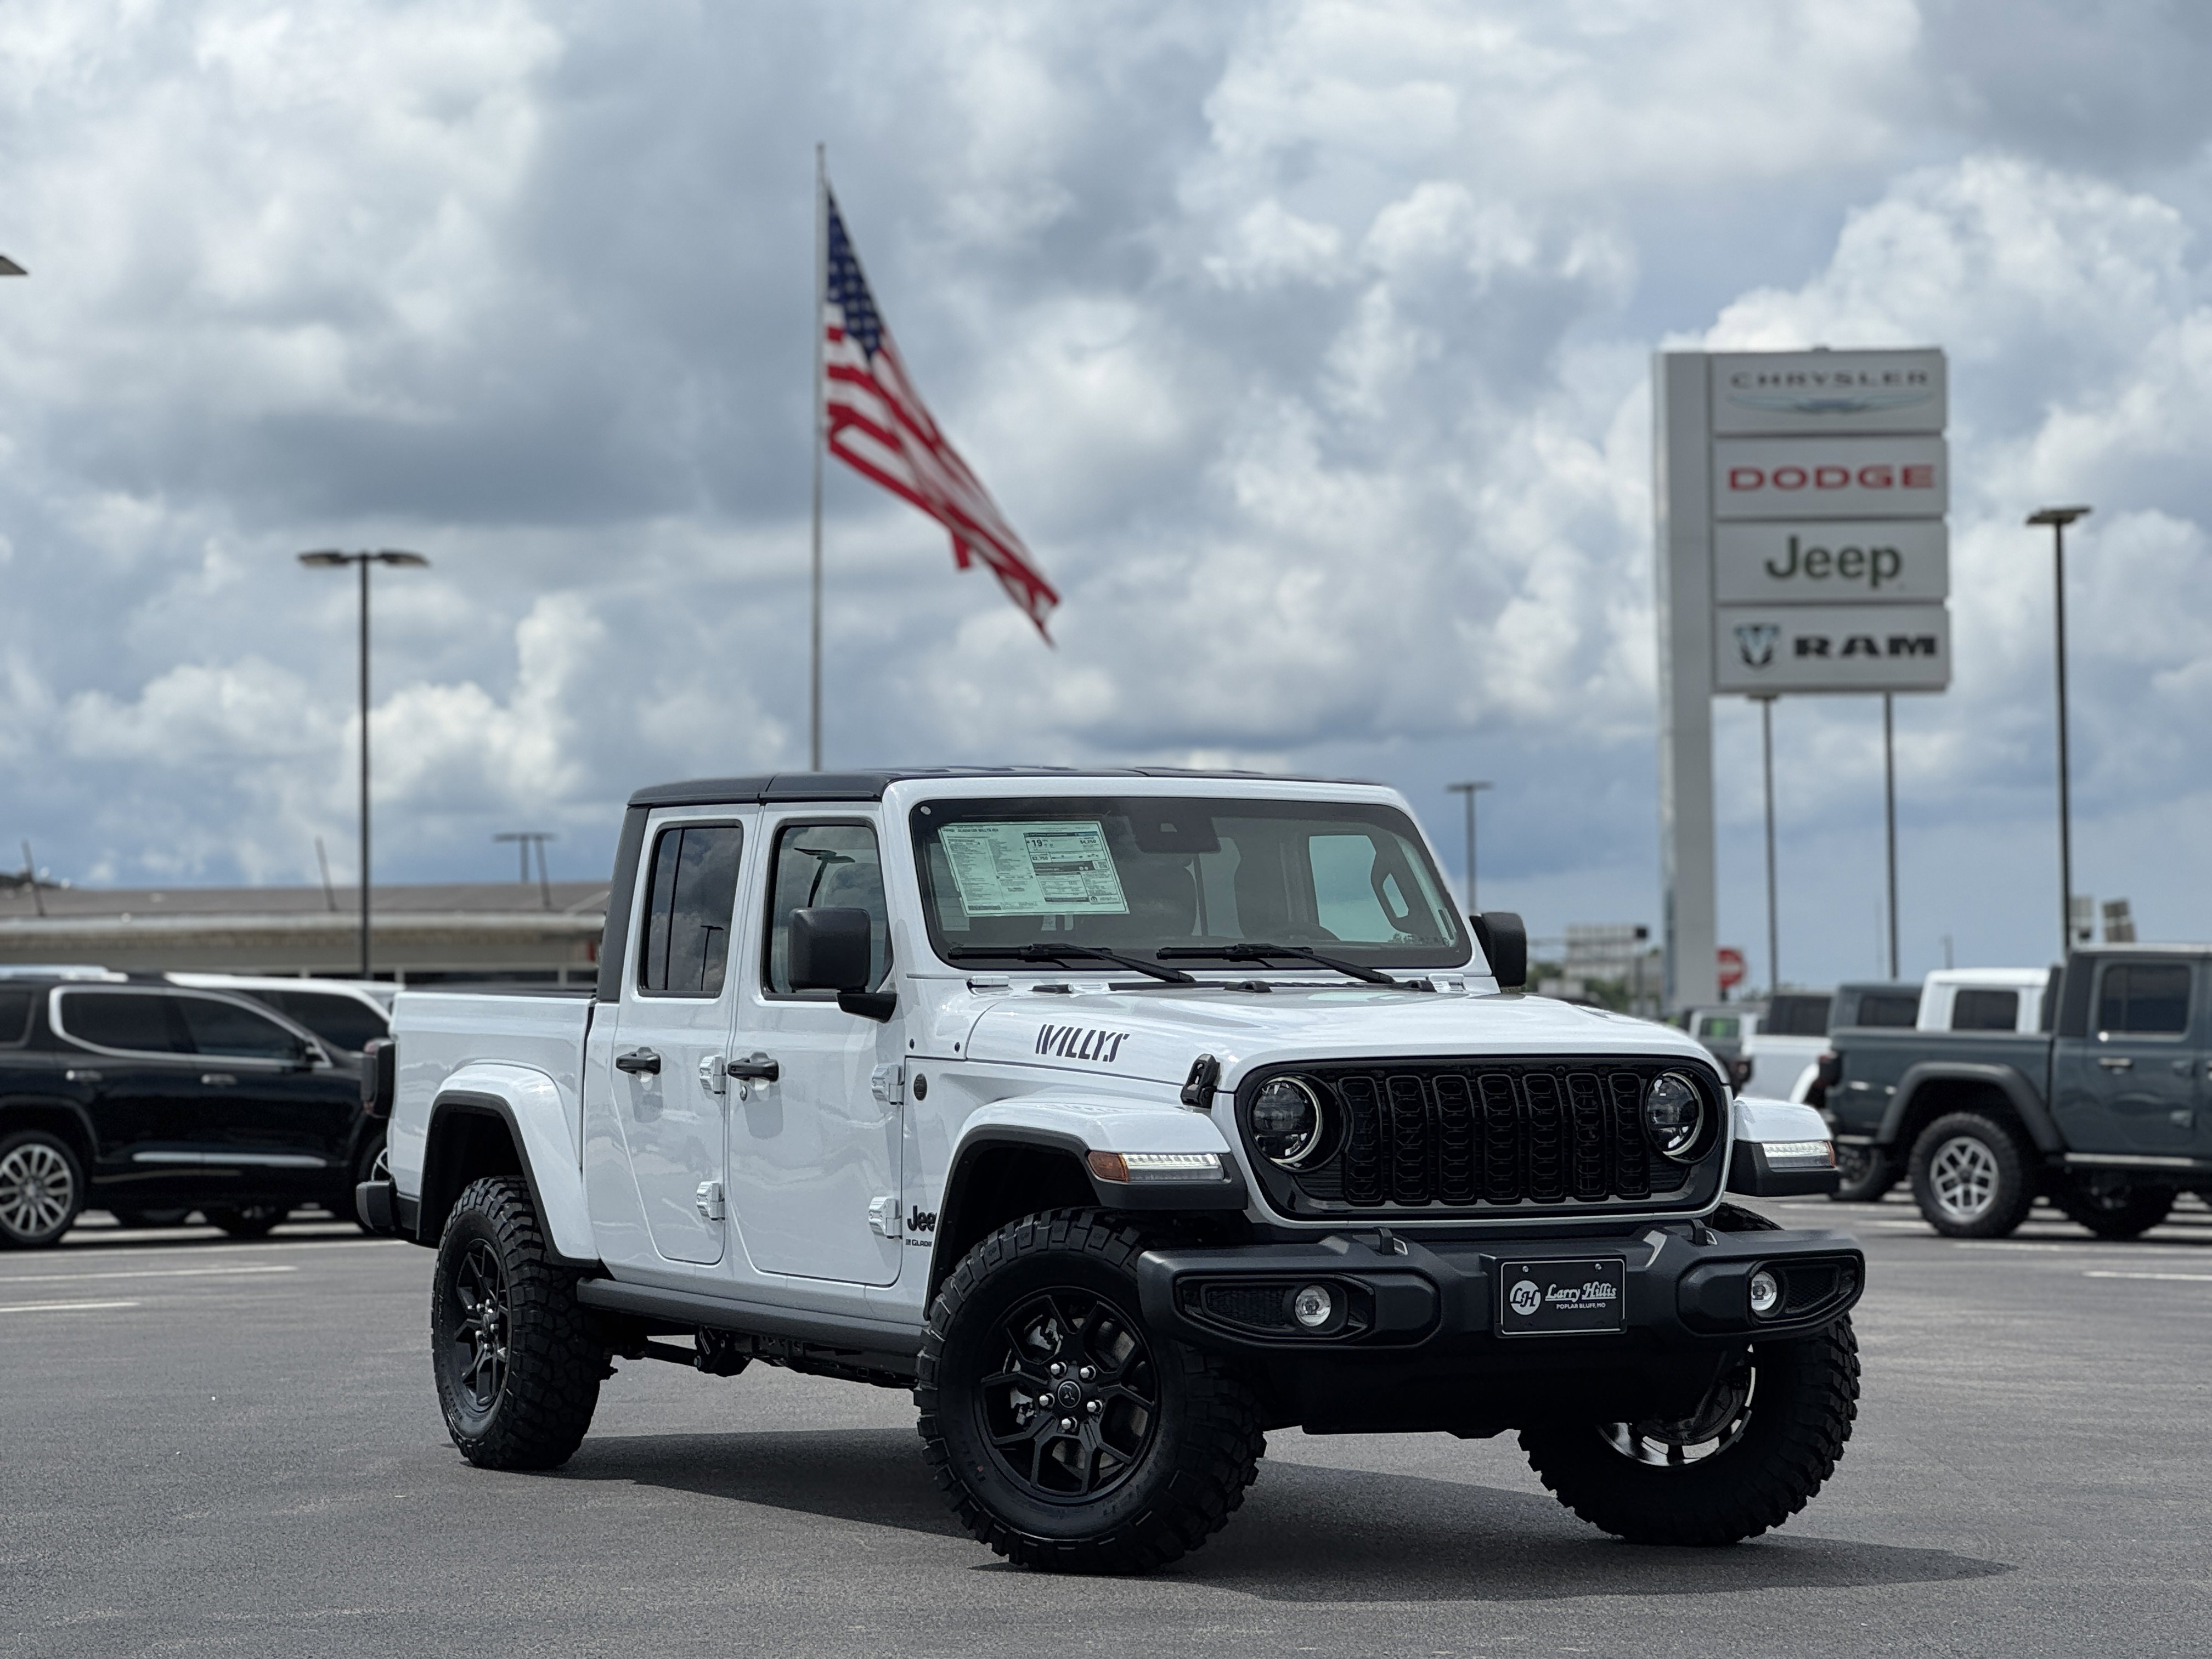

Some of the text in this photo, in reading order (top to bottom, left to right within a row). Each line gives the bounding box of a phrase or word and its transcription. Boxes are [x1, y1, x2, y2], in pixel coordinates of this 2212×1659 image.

[1730, 370, 1929, 389] CHRYSLER
[1728, 464, 1934, 490] DODGE
[1764, 534, 1903, 590] Jeep
[1793, 635, 1937, 657] RAM
[1031, 839, 1042, 847] 19
[1035, 1024, 1131, 1063] WILLYS
[907, 1205, 938, 1232] Jee
[1545, 1281, 1617, 1302] Larry Hillis
